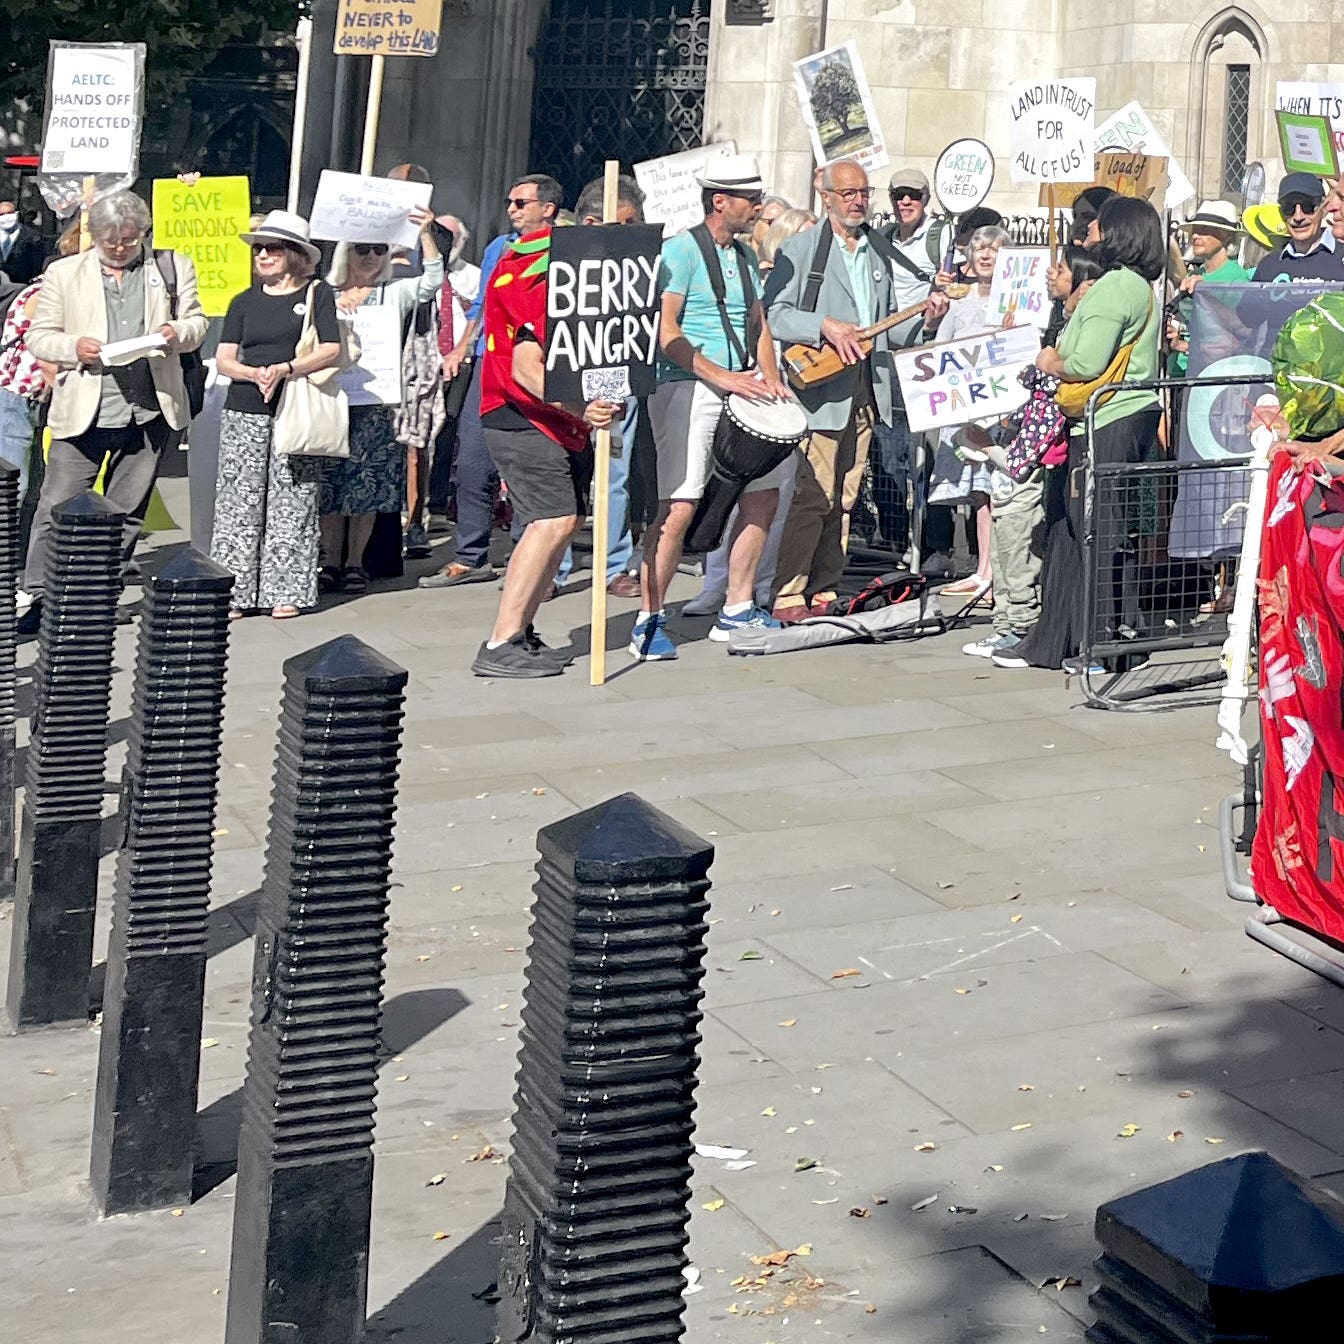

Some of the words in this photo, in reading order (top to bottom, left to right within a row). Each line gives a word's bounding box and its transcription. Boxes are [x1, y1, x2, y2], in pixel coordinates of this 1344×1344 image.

[343, 11, 394, 28] NEVER
[395, 9, 413, 27] to
[338, 31, 384, 50] develop
[388, 30, 411, 48] this
[53, 94, 102, 106] HANDS
[105, 94, 131, 106] OFF
[1011, 85, 1043, 121] LAND
[1045, 83, 1060, 105] IN
[1060, 85, 1093, 121] TRUST
[1319, 96, 1342, 119] IT'S
[52, 116, 131, 129] PROTECTED
[1037, 120, 1063, 140] FOR
[70, 137, 110, 148] LAND
[945, 154, 988, 175] GREEN
[1016, 151, 1036, 175] ALL
[1107, 155, 1133, 175] load
[1133, 156, 1147, 181] of
[172, 192, 222, 213] SAVE
[1002, 256, 1041, 280] SAVE
[547, 254, 663, 318] BERRY
[998, 290, 1043, 314] LUNGS
[546, 311, 661, 372] ANGRY
[912, 338, 1007, 382] SAVE
[929, 374, 1009, 416] PARK
